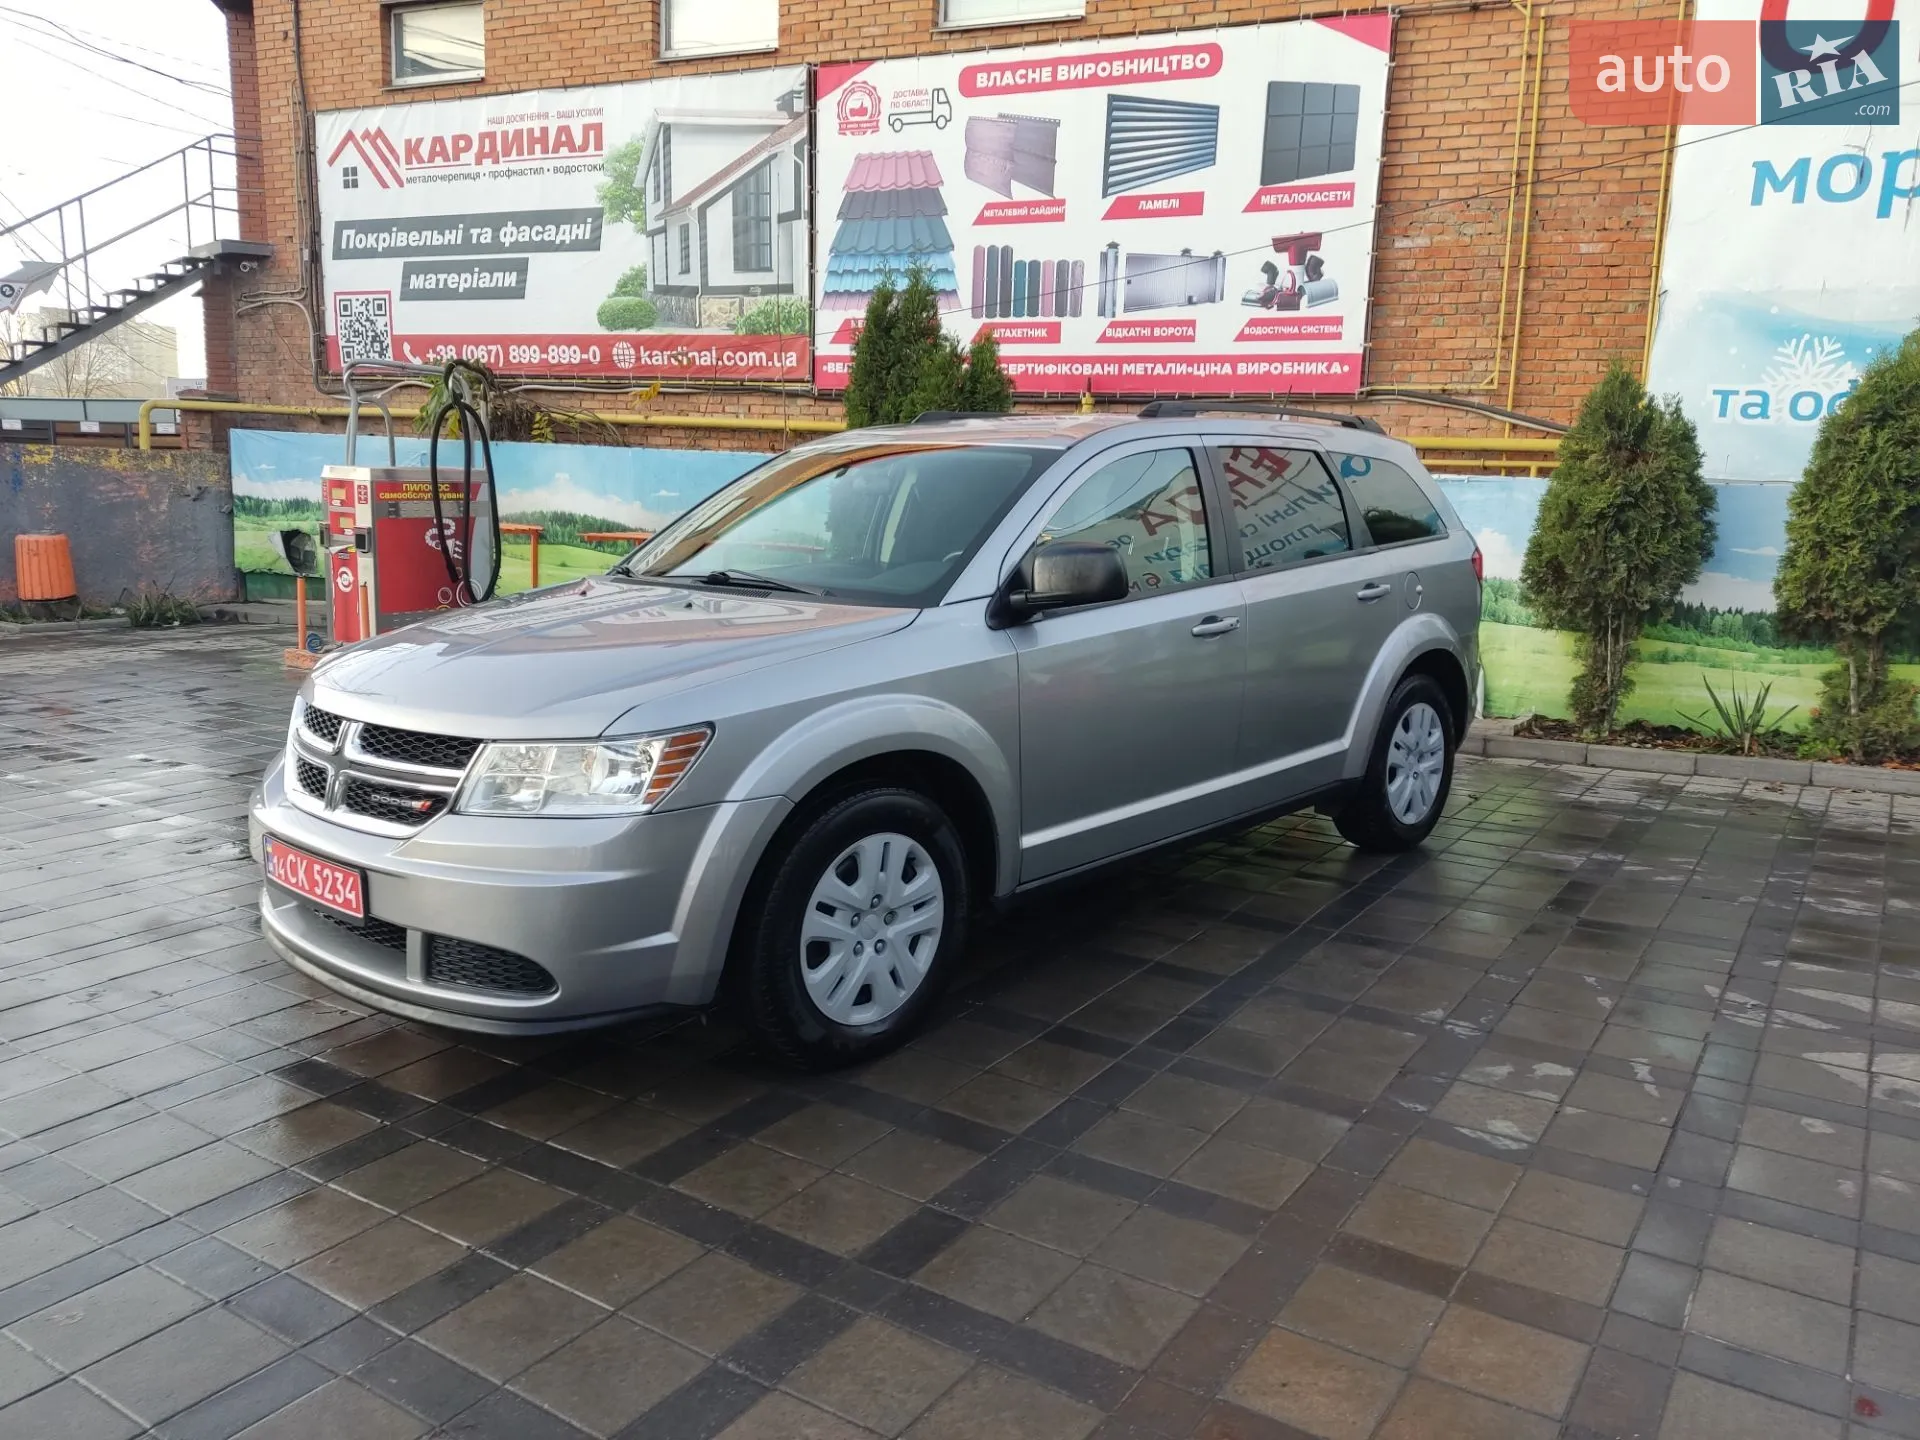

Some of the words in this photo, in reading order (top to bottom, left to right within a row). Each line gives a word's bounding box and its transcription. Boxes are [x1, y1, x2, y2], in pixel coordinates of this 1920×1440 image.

[976, 66, 1052, 88] ВЛАСНЕ
[1056, 52, 1211, 81] ВИРОБНИЦТВО
[892, 88, 929, 99] ДОСТАВКА
[891, 101, 900, 109] ПО
[902, 99, 931, 108] ОБЛАСТІ
[487, 116, 505, 126] НАШІ
[505, 111, 550, 125] ДОСЯГНЕННЯ
[556, 109, 575, 120] ВАШІ
[404, 122, 604, 166] КАРДИНАЛ
[406, 170, 481, 184] металочерепиця
[488, 166, 544, 182] профнастил
[552, 163, 605, 175] водостоки
[1138, 198, 1180, 210] ЛАМЕЛІ
[1260, 190, 1352, 205] МЕТАЛОКАСЕТИ
[983, 206, 1028, 218] МЕТАЛЕВИЙ
[1029, 204, 1066, 216] САЙДИНГ
[341, 223, 464, 251] Покрівельні
[469, 227, 492, 244] та
[500, 218, 593, 249] фасадні
[409, 267, 518, 292] матеріали
[992, 327, 1048, 338] ШТАХЕТНИК
[1105, 327, 1151, 339] ВІДКАТНІ
[1153, 326, 1195, 337] ВОРОТА
[1243, 325, 1300, 335] ВОДОСТІЧНА
[1301, 324, 1343, 334] СИСТЕМА
[462, 344, 504, 367] (067)
[508, 345, 601, 365] 899-899-0
[1712, 389, 1771, 420] та
[313, 863, 357, 909] 5234
